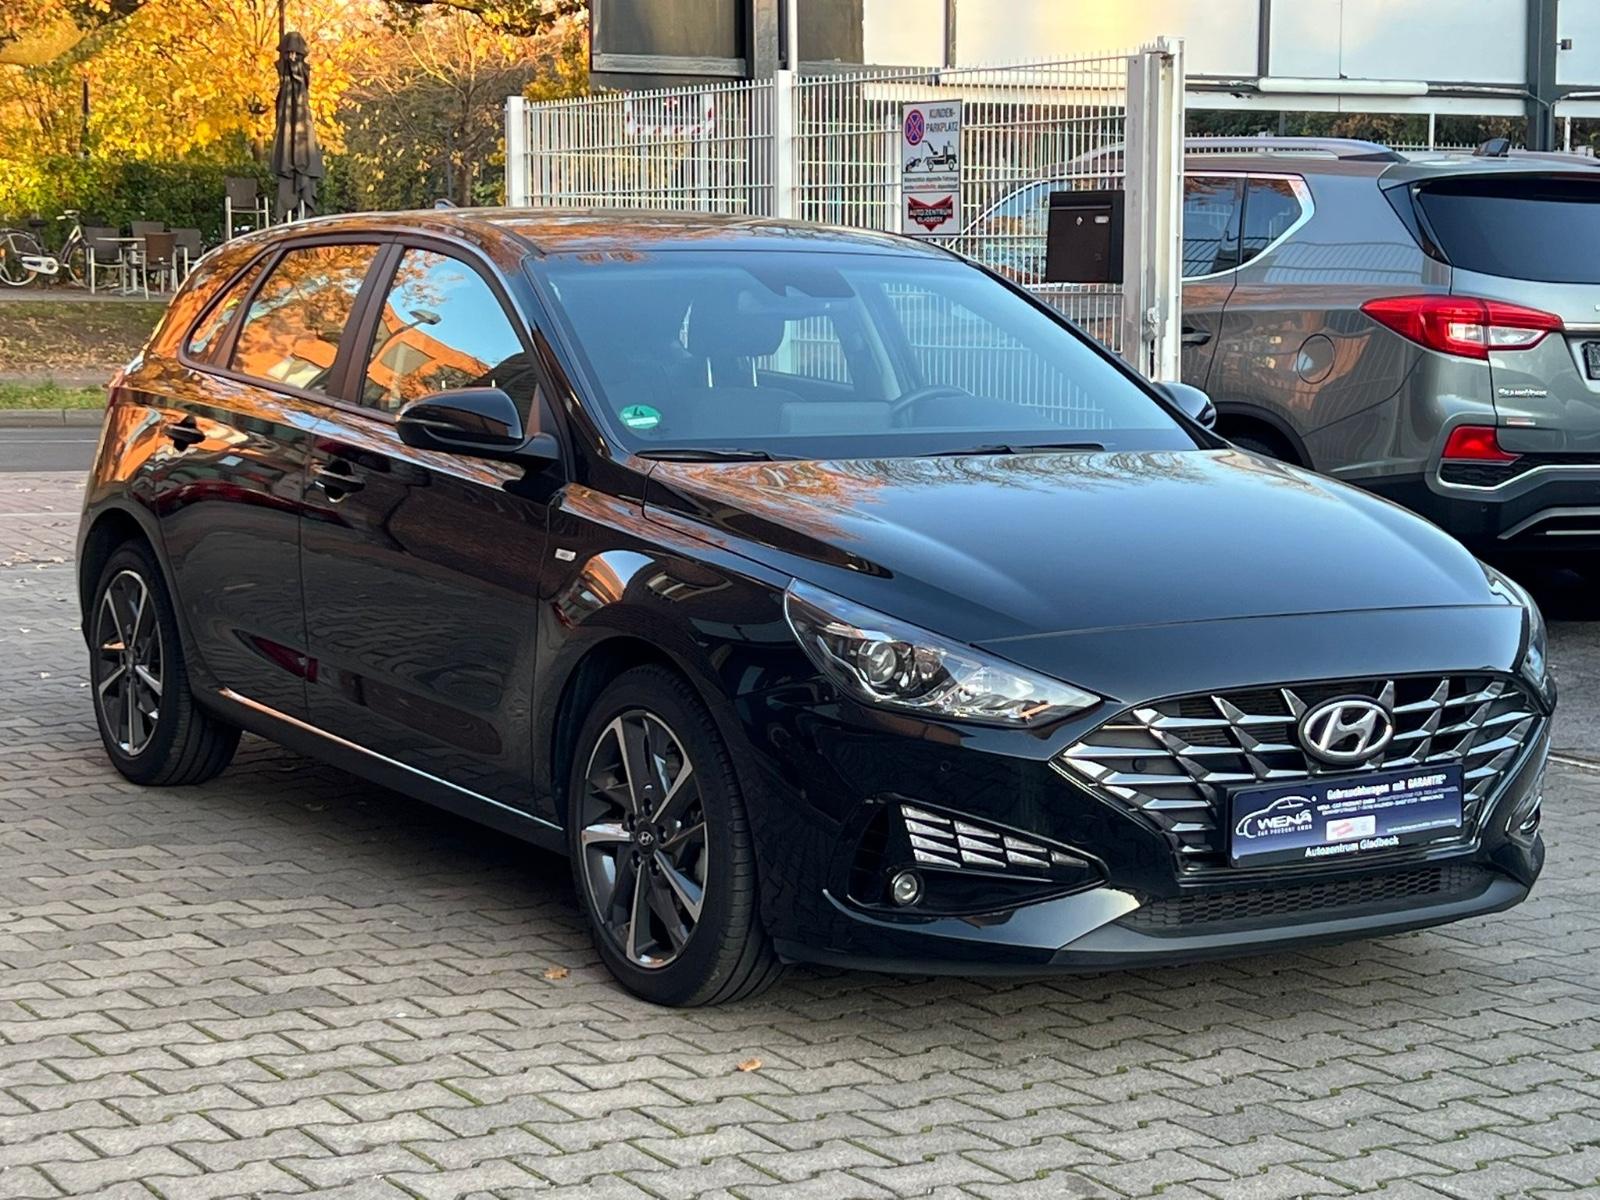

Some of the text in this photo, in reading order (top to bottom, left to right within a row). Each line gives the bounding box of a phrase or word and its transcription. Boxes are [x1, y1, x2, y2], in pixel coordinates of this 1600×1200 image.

[929, 107, 956, 118] KUNDEN-
[926, 121, 959, 133] PARKPLATZ
[1327, 783, 1390, 801] Gebrauchtwagen
[1392, 780, 1406, 792] mit
[1304, 835, 1400, 858] Autozentrum Gladbeck
